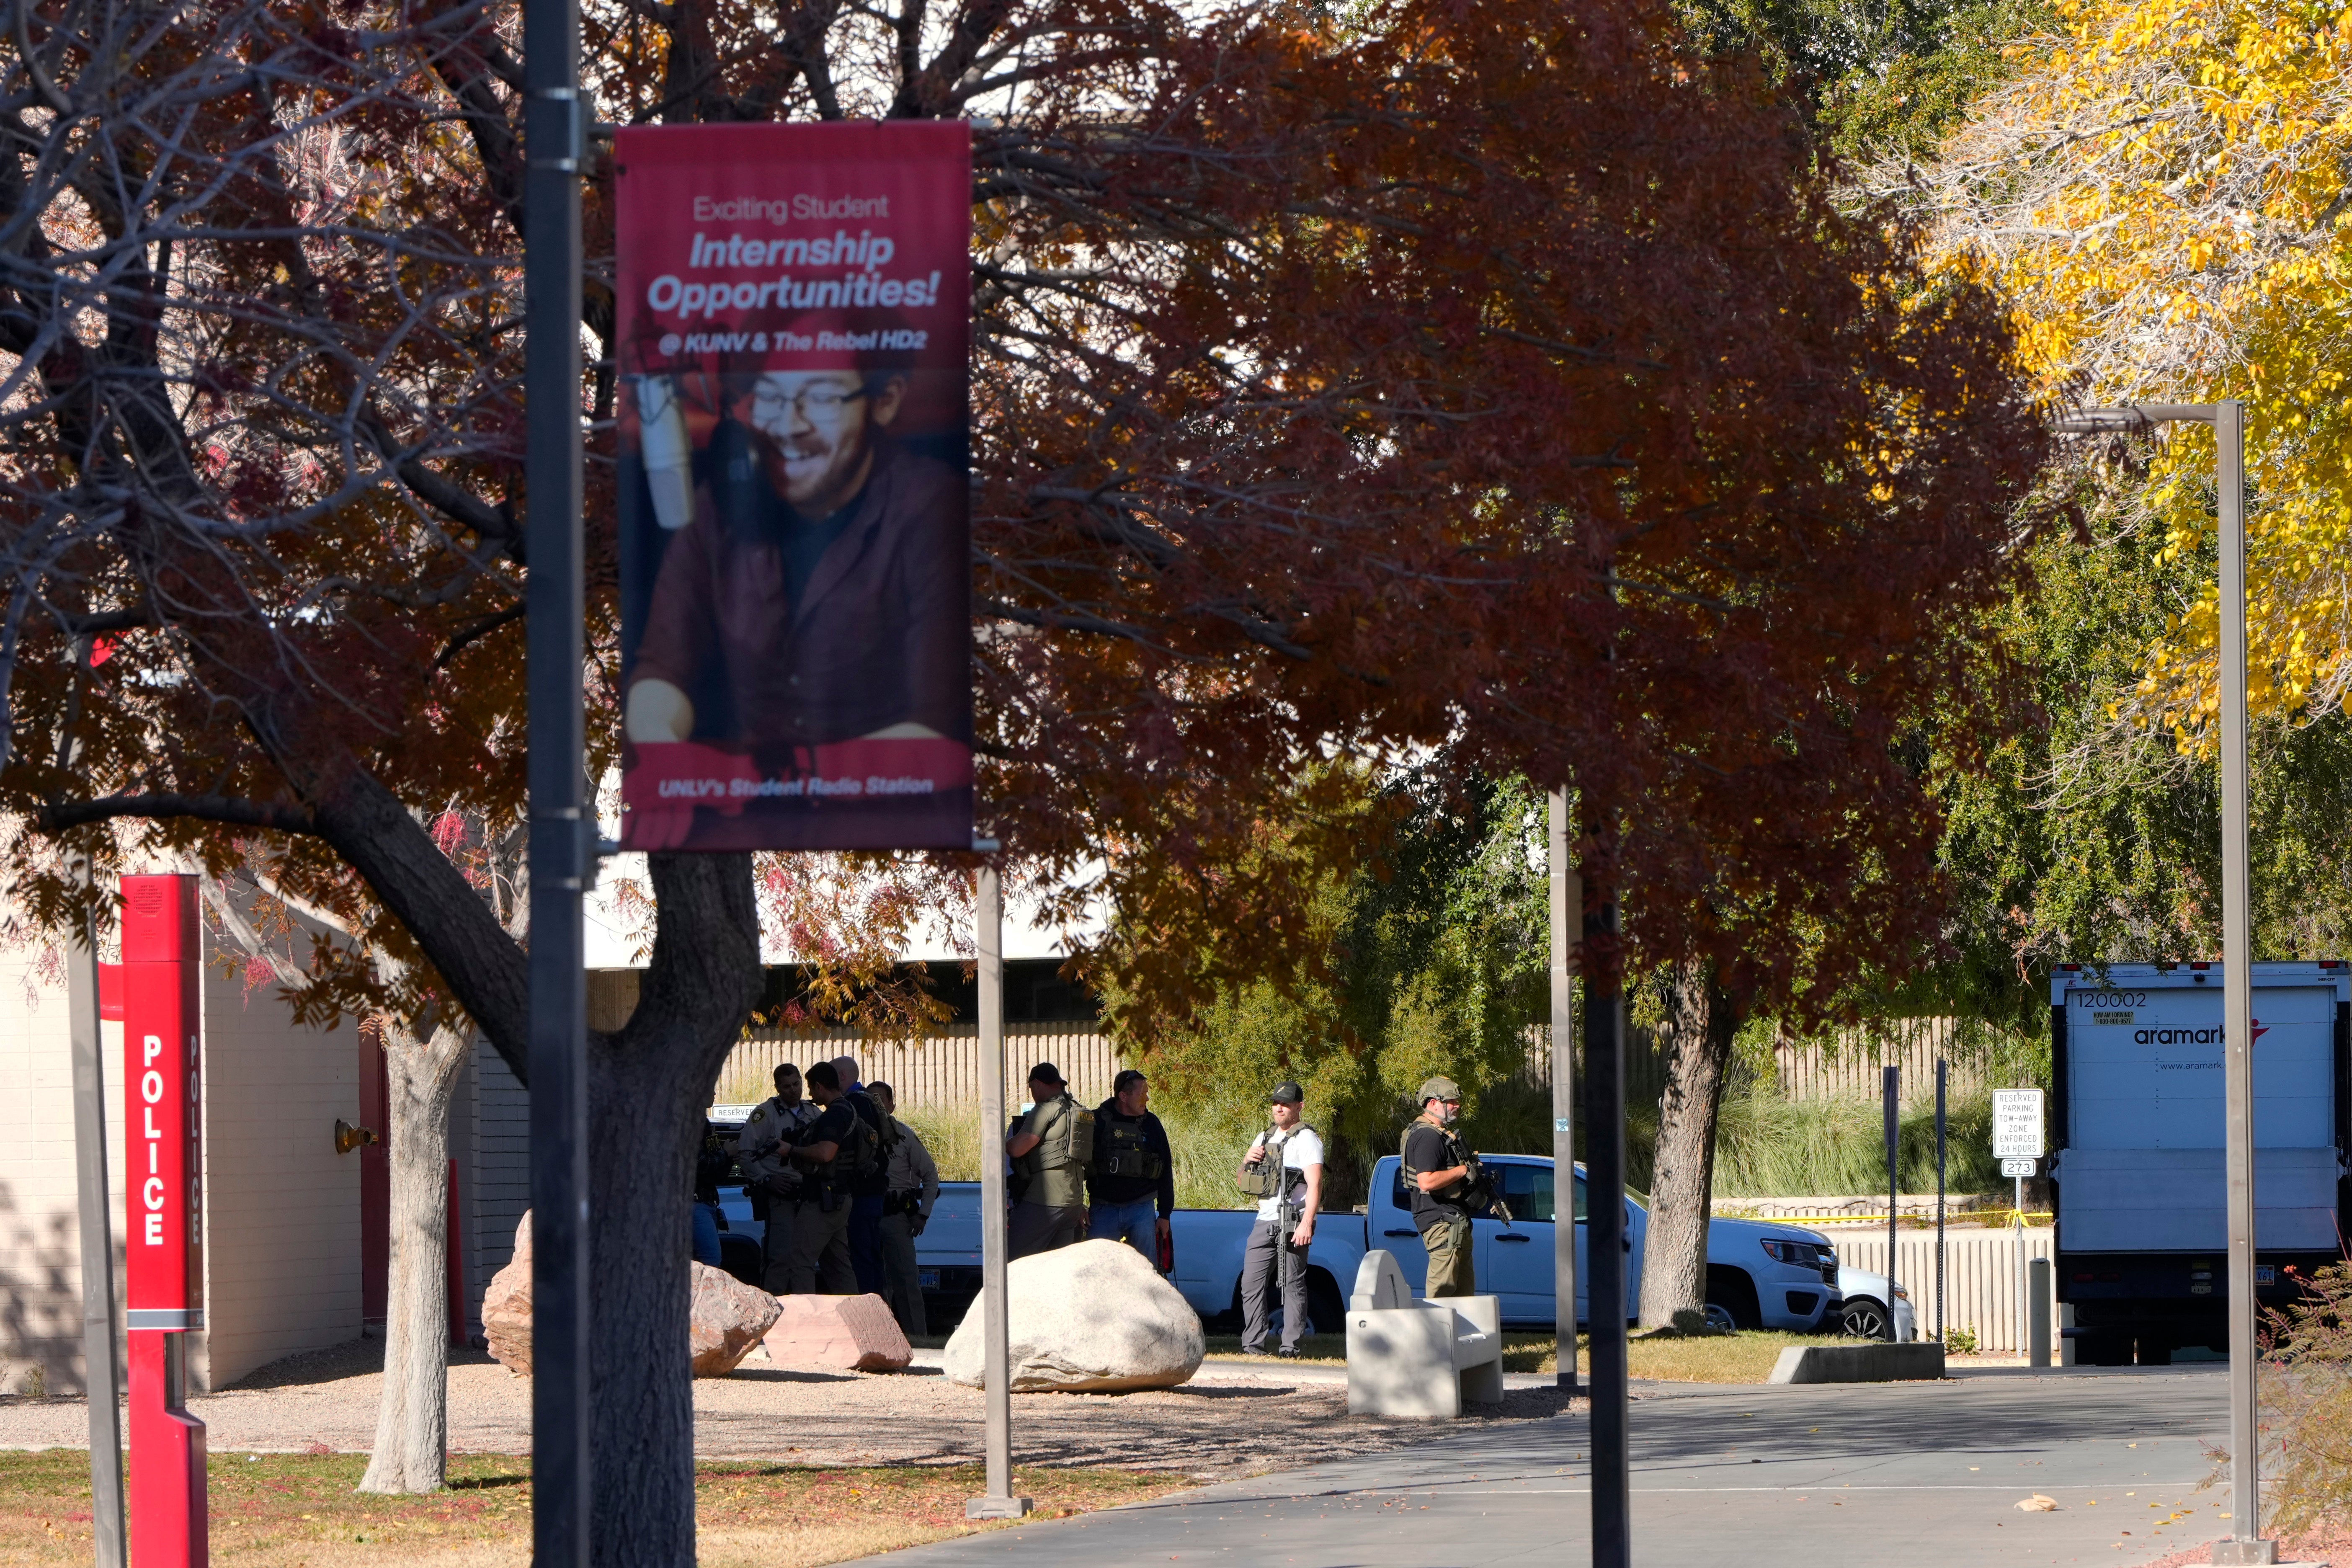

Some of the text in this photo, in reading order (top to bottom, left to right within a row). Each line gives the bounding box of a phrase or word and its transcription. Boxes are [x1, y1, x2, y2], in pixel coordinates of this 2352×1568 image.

[694, 193, 889, 226] Exciting Student
[689, 230, 895, 272] Internship
[648, 271, 941, 319] Opportunities!
[659, 330, 928, 356] @ KUNV & The Rebel HD2
[659, 776, 934, 797] UNLV's Student Radio Station
[2077, 993, 2146, 1008] 120002
[2160, 1061, 2226, 1070] www.aramark.
[142, 1035, 164, 1245] POLICE
[190, 1035, 199, 1244] POLICE
[2007, 1163, 2030, 1172] 273
